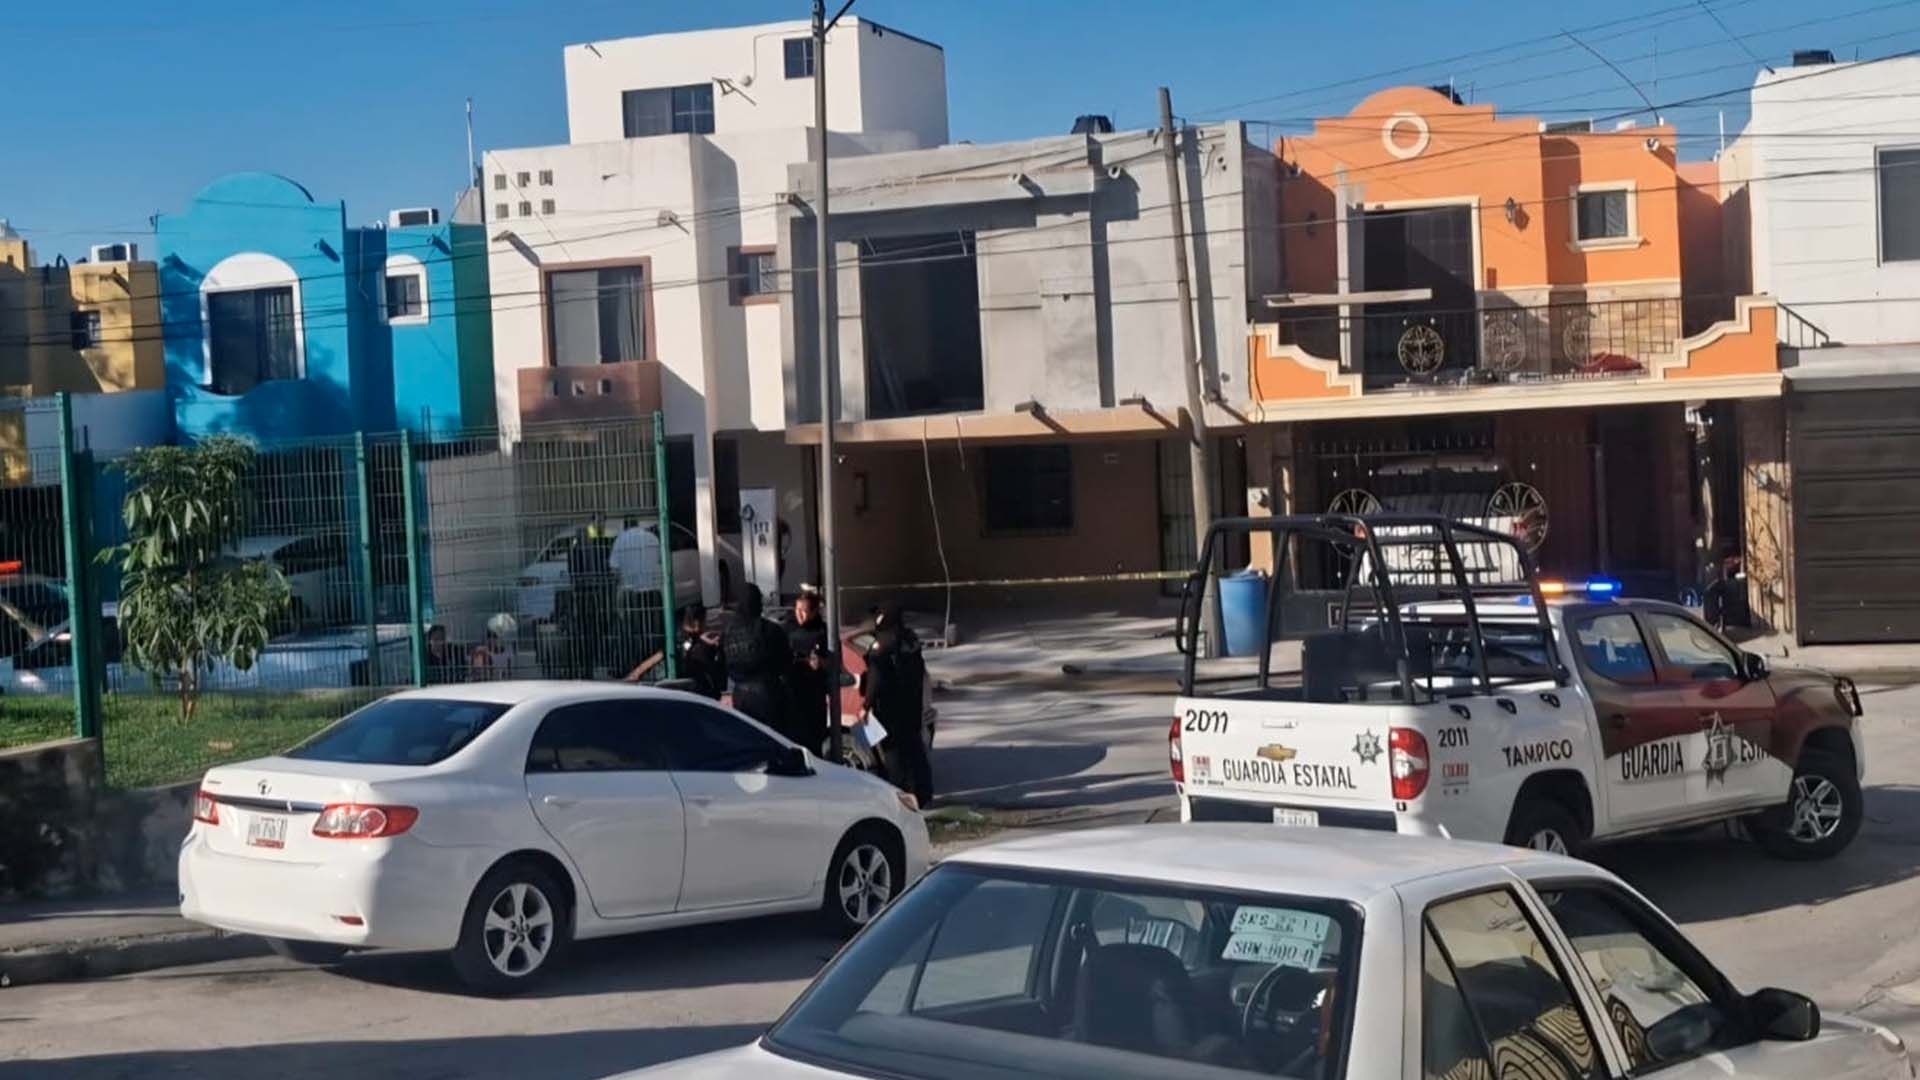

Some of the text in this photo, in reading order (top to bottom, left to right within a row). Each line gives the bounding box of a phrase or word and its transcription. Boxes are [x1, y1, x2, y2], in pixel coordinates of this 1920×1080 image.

[1185, 709, 1229, 734] 2011
[1438, 726, 1470, 748] 2011
[1502, 739, 1573, 767] TAMPICO
[1621, 741, 1684, 780] GUARDIA
[1222, 758, 1287, 785] GUARDIA
[1293, 763, 1358, 790] ESTATAL
